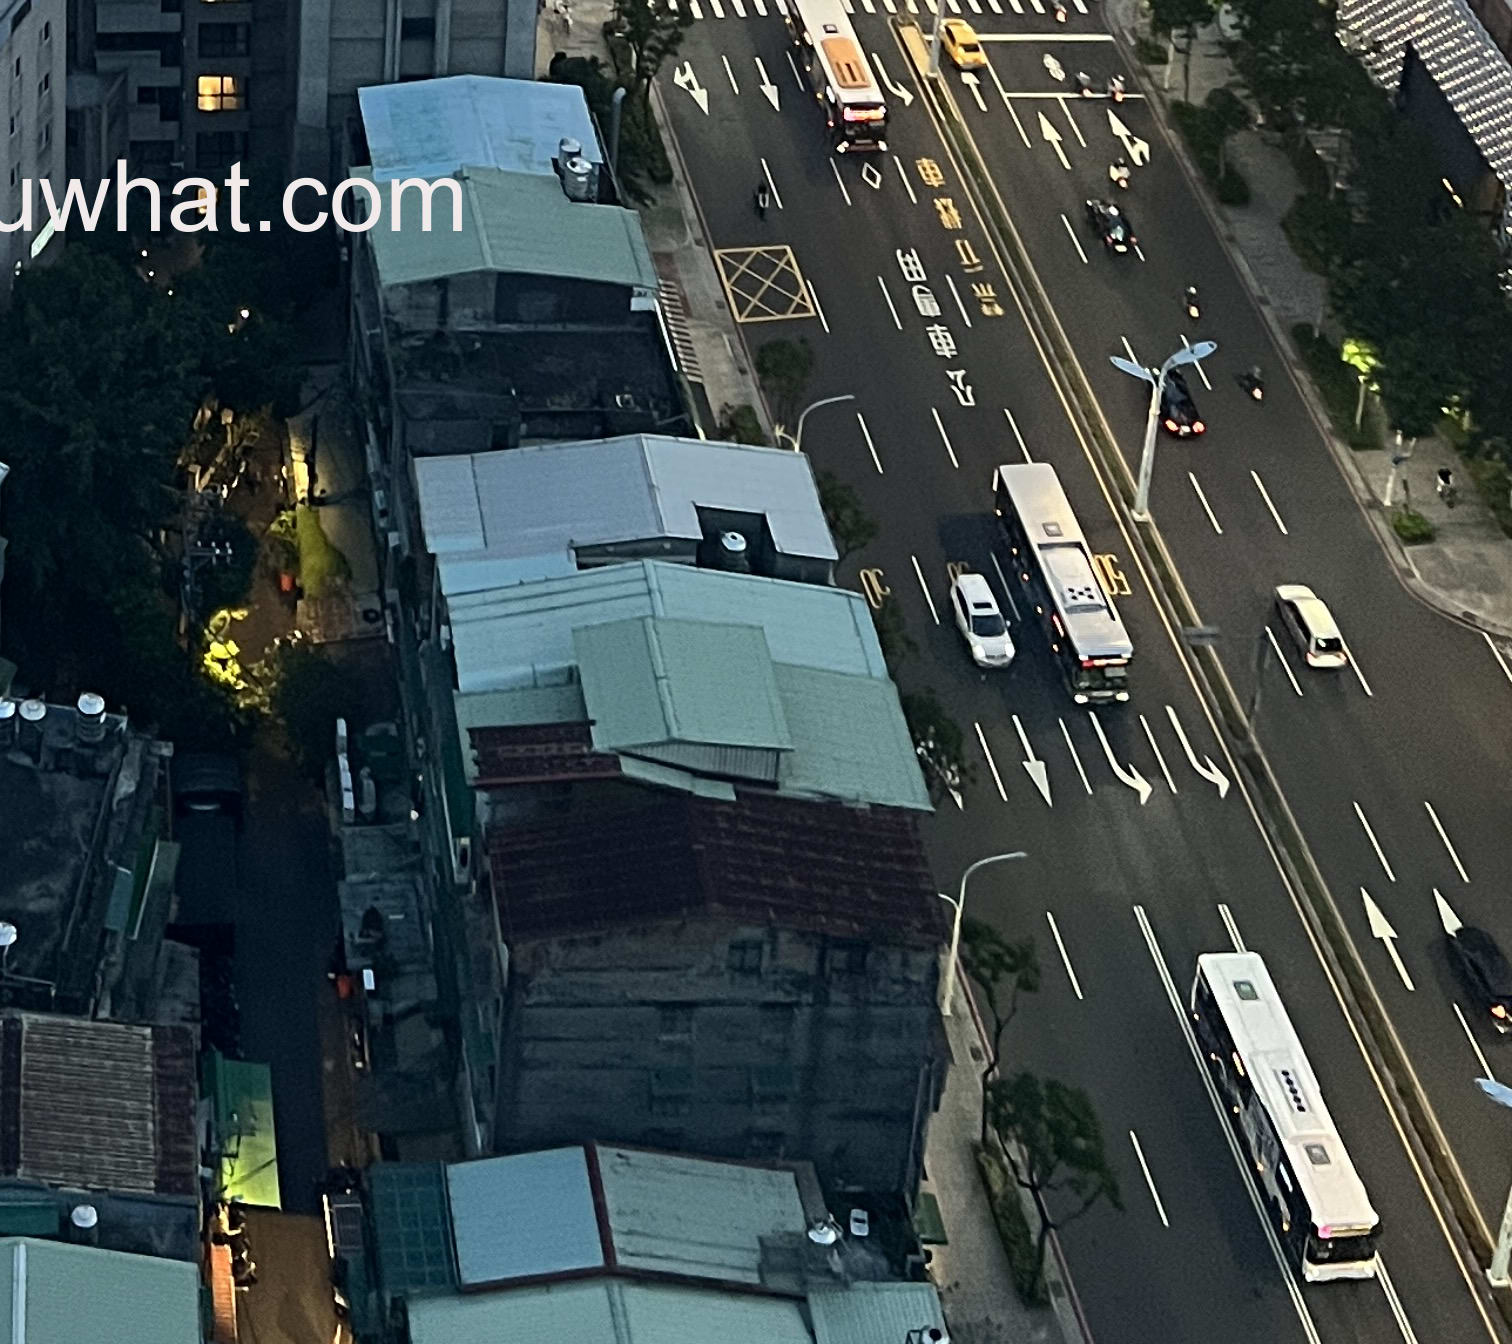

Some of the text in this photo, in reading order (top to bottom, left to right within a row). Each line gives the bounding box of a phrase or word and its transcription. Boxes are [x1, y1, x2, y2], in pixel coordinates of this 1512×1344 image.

[896, 247, 977, 407] 公車專用
[1093, 553, 1133, 596] 50
